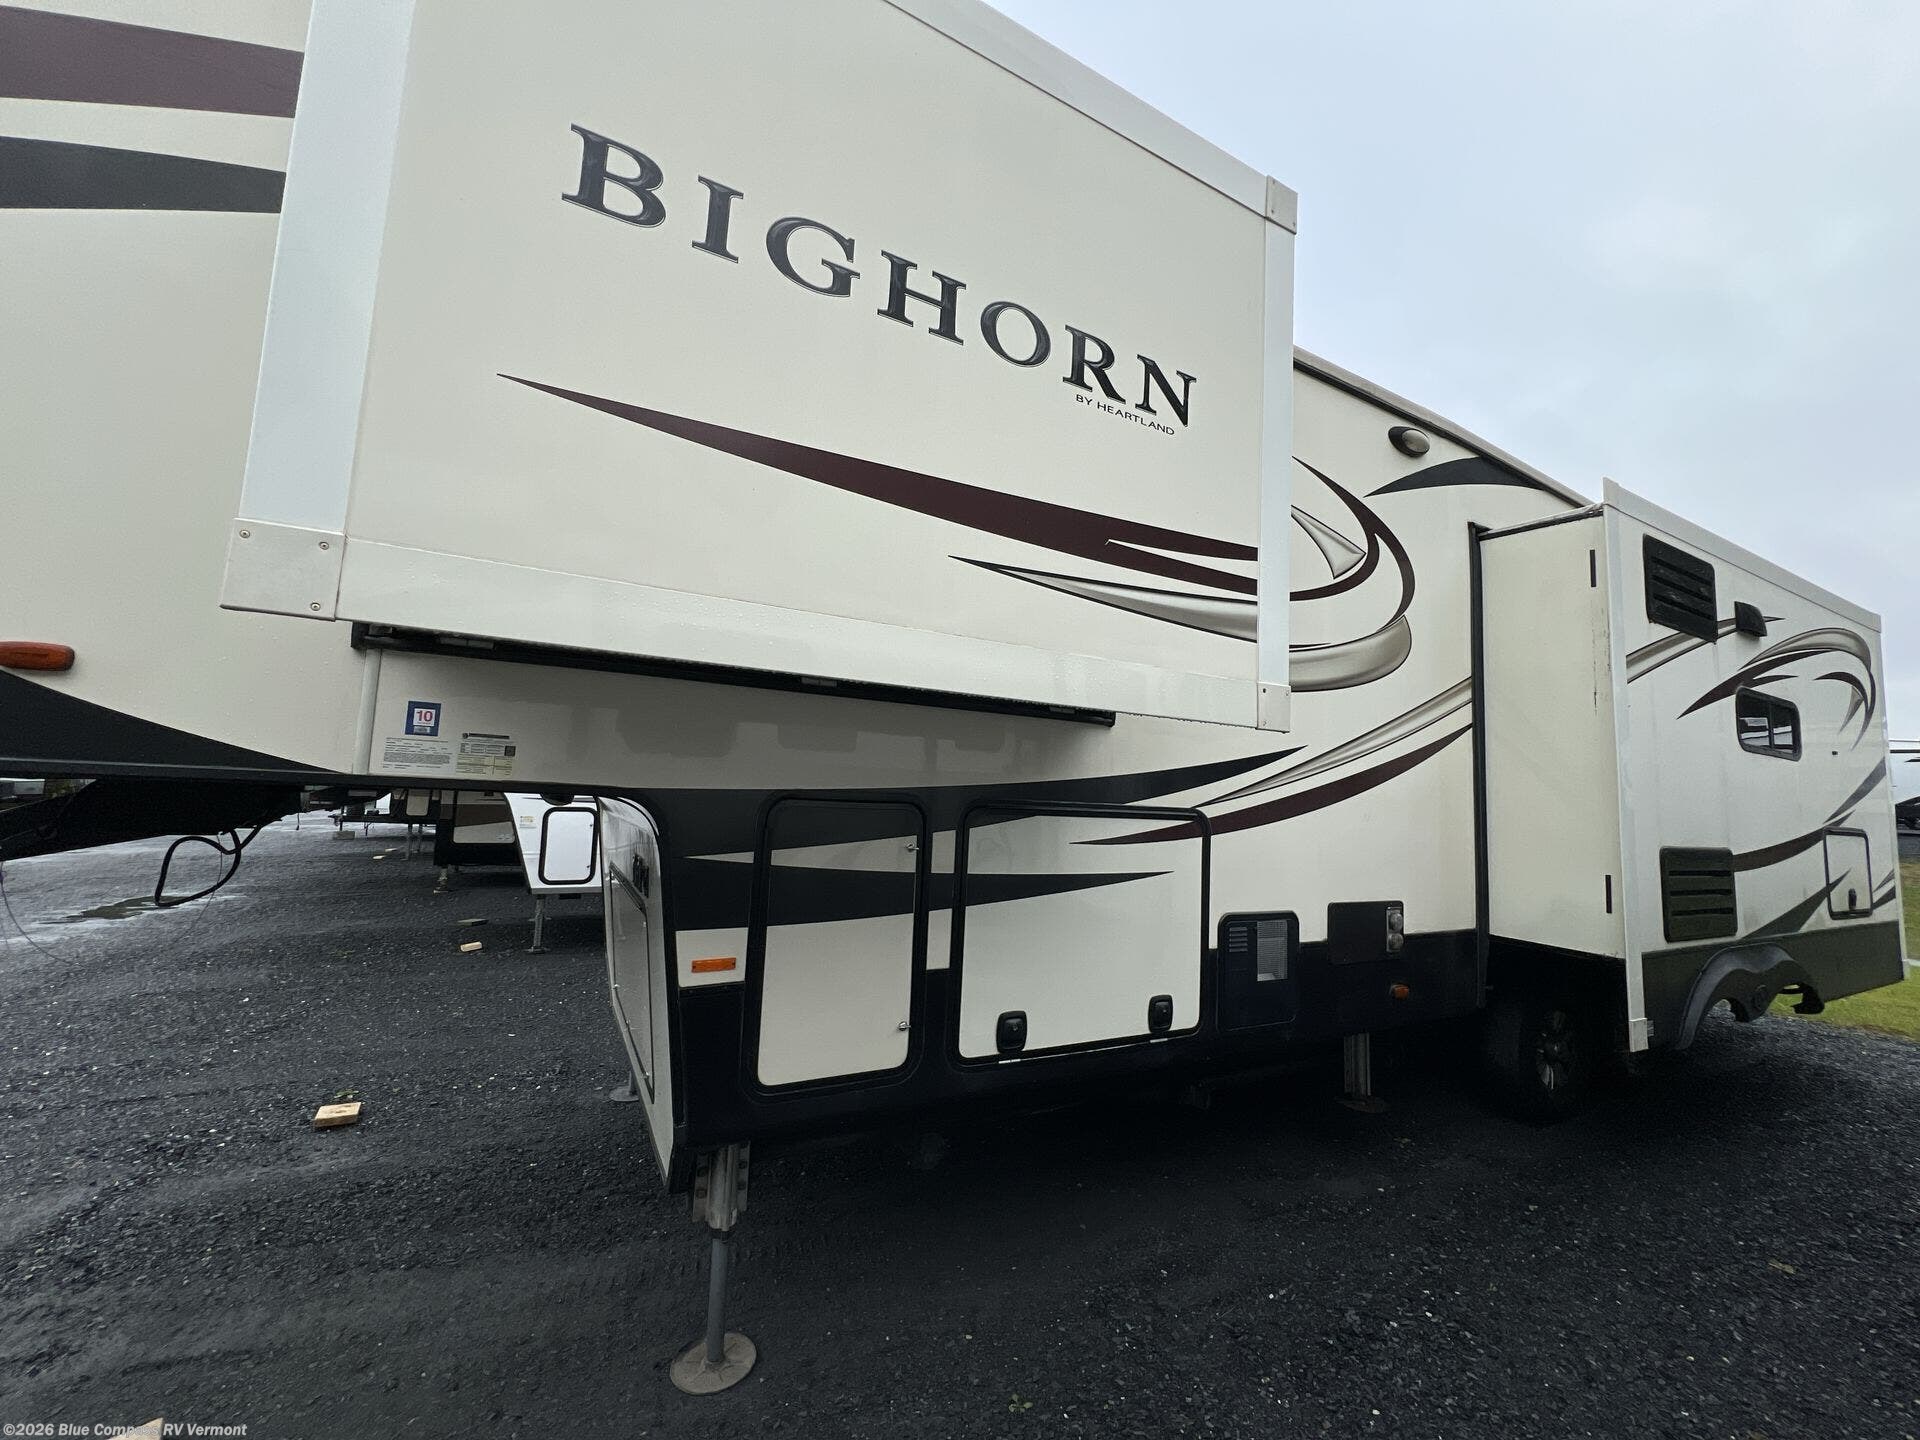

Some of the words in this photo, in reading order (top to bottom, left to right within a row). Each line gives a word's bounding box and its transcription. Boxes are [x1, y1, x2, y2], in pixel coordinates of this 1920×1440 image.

[561, 123, 1197, 427] BIGHORN
[1075, 394, 1093, 405] BY
[1097, 401, 1175, 436] HEARTLAND
[416, 710, 433, 722] 10
